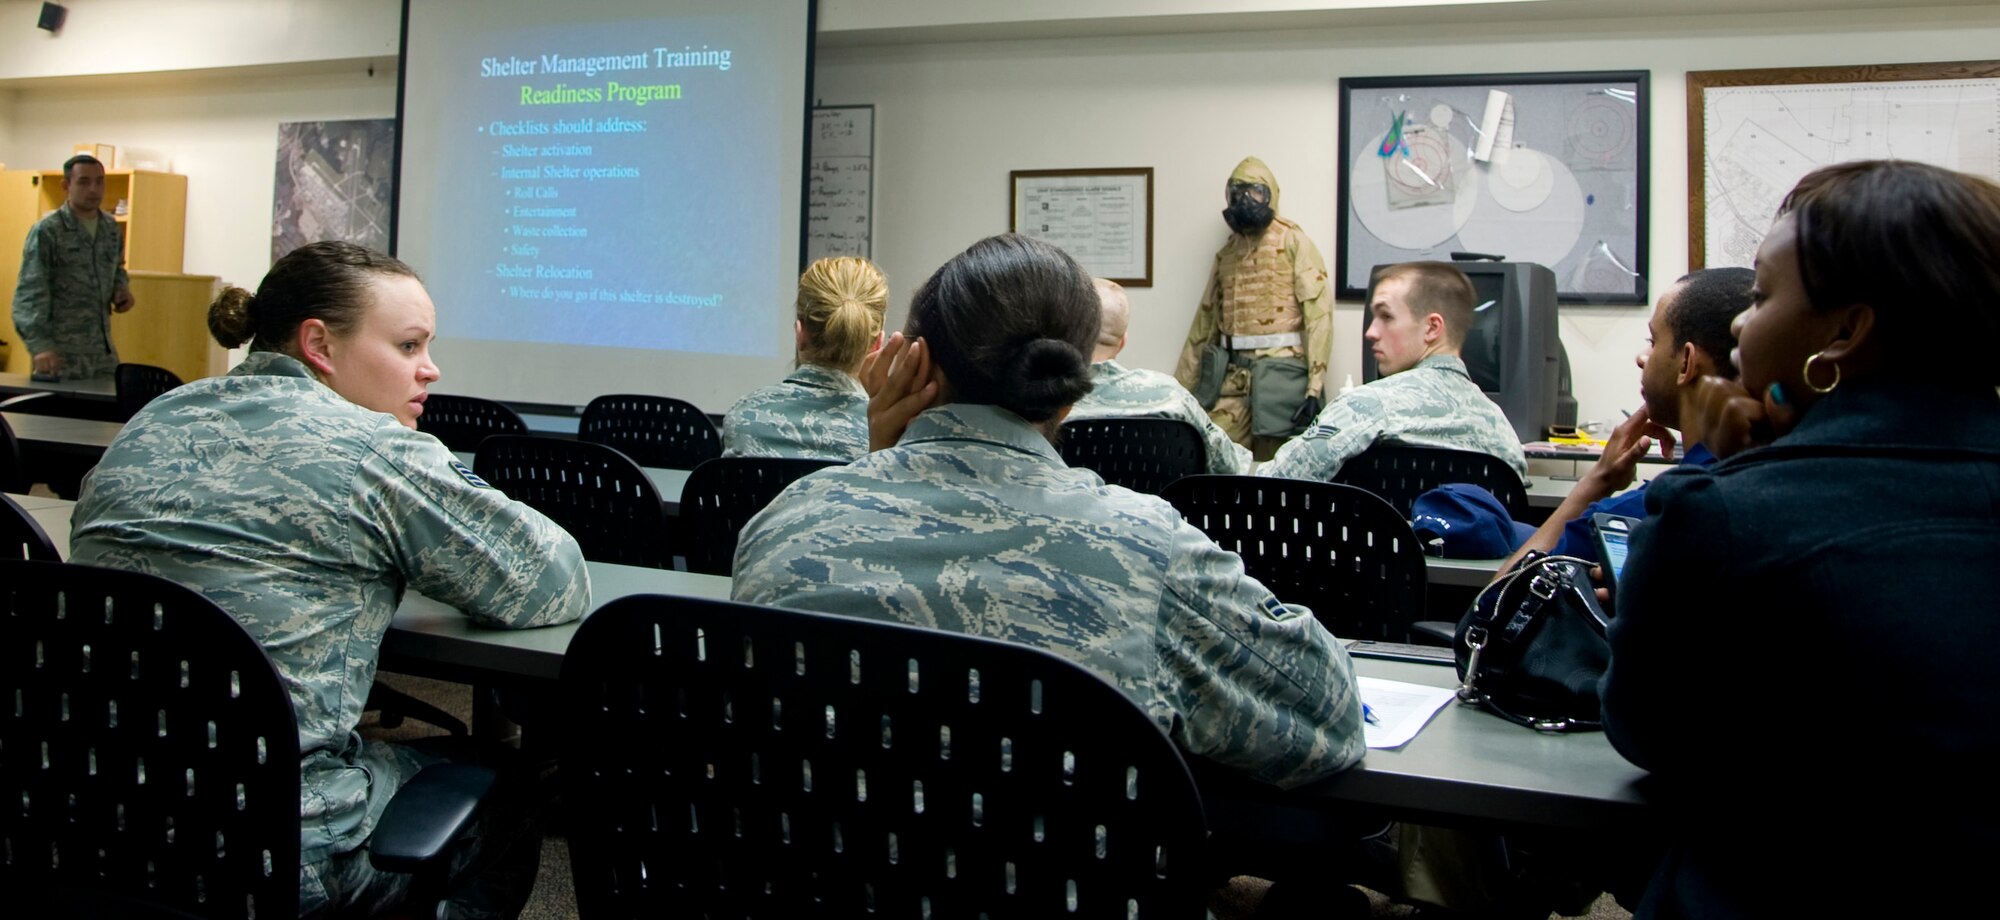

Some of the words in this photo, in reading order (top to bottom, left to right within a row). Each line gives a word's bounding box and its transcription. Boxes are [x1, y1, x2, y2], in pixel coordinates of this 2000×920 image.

[481, 56, 537, 77] Shelter
[540, 54, 648, 77] Management
[653, 45, 732, 70] Training
[520, 84, 602, 105] Readiness
[607, 81, 682, 106] Program
[489, 119, 549, 136] Checklists
[553, 118, 593, 134] should
[596, 117, 647, 133] address:
[502, 144, 538, 157] Shelter
[541, 143, 592, 156] activation
[502, 166, 540, 179] Internal
[543, 165, 581, 178] Shelter
[583, 164, 640, 181] operations
[514, 187, 534, 198] Roll
[535, 187, 558, 198] Calls
[513, 206, 577, 217] Entertainment
[512, 224, 541, 236] Waste
[542, 224, 588, 237] collection
[511, 244, 539, 259] Safety
[496, 263, 532, 278] Shelter
[536, 264, 593, 279] Relocation
[510, 286, 540, 299] Where
[541, 287, 554, 299] do
[554, 289, 574, 302] you
[575, 290, 587, 303] go
[589, 288, 599, 300] if
[599, 288, 617, 301] this
[619, 289, 652, 303] shelter
[654, 291, 664, 303] is
